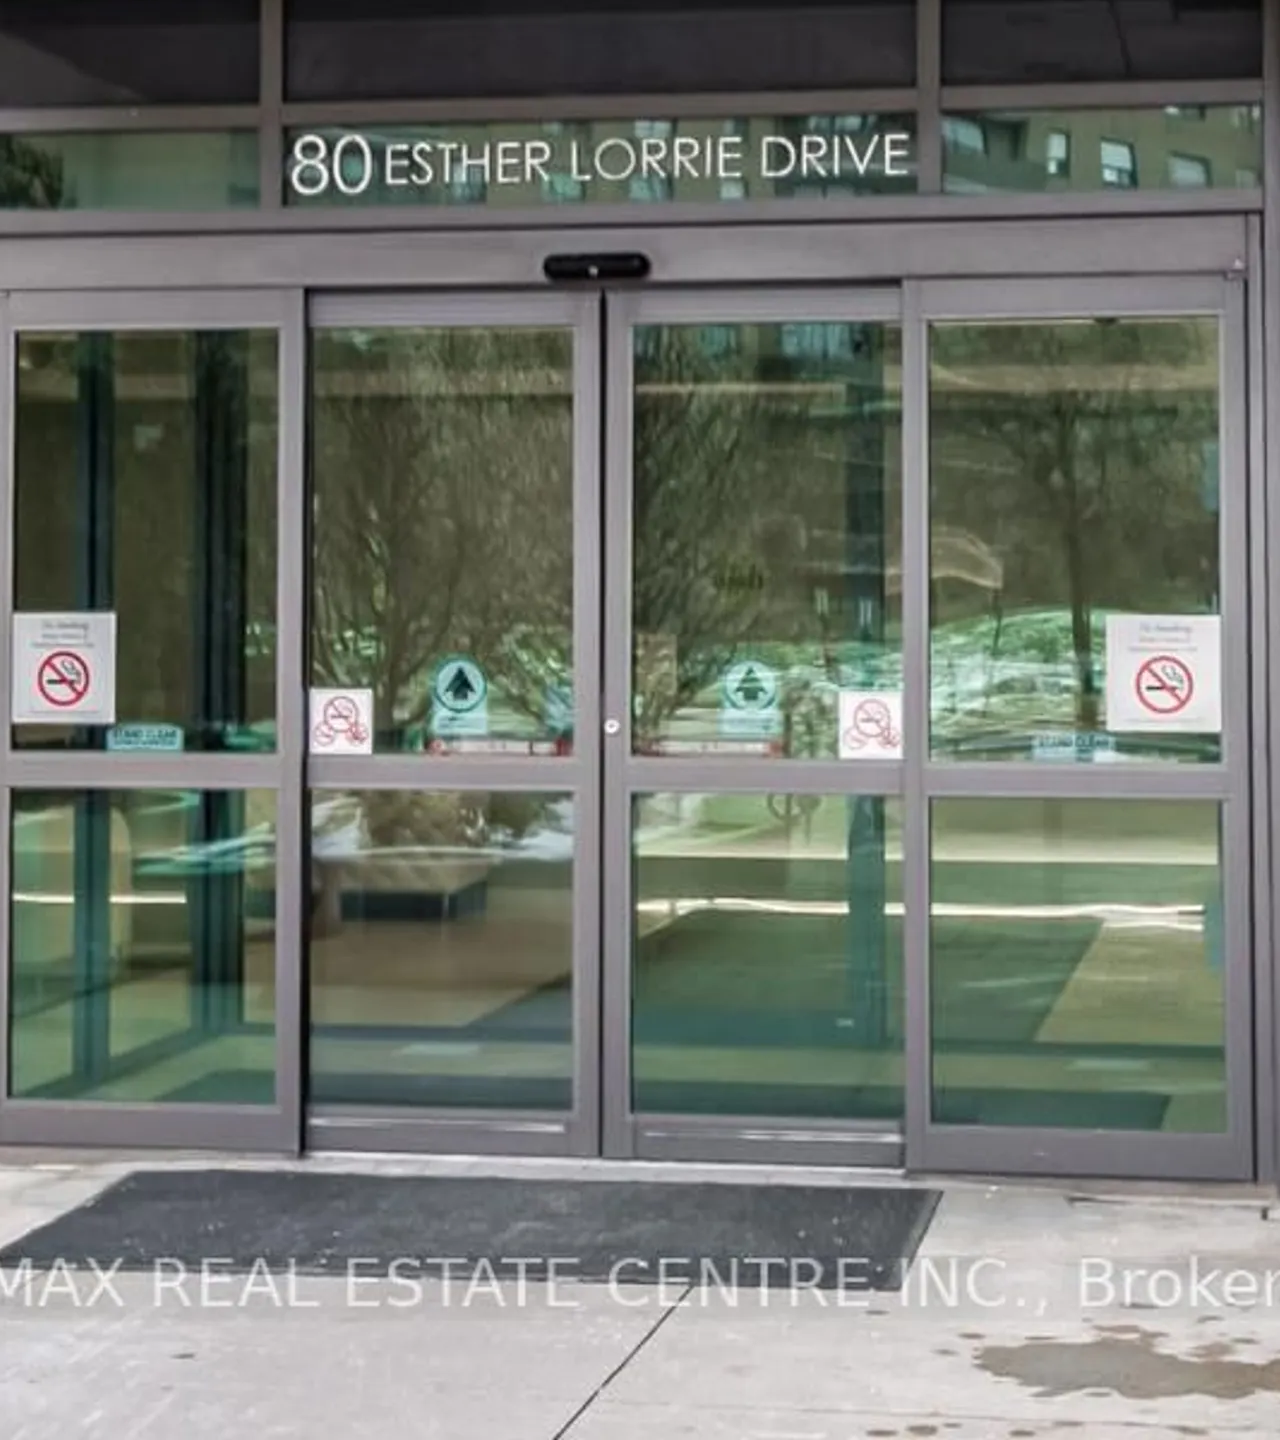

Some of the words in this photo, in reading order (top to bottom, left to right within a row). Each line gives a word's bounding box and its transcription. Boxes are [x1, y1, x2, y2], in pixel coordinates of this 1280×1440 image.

[291, 133, 372, 195] 80
[385, 140, 552, 185] ESTHER
[571, 136, 743, 181] LORRIE
[761, 133, 910, 178] DRIVE
